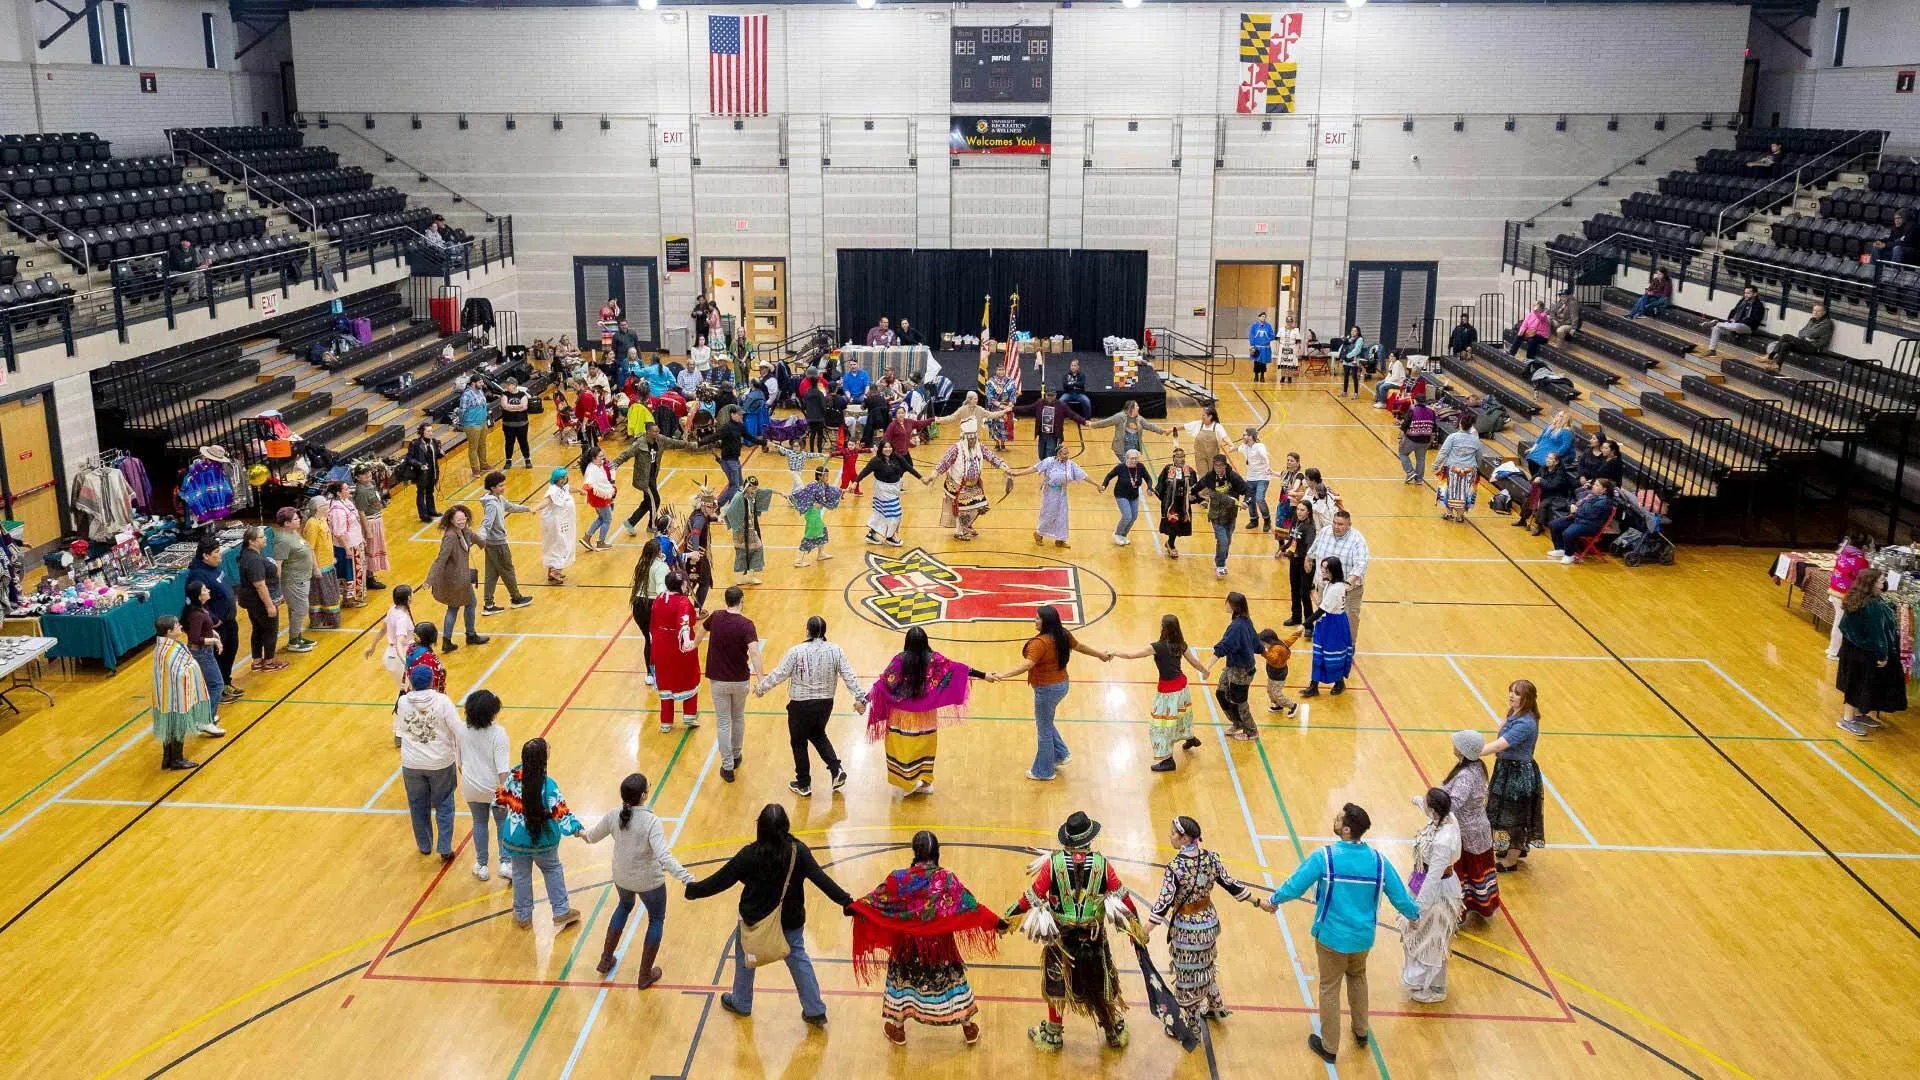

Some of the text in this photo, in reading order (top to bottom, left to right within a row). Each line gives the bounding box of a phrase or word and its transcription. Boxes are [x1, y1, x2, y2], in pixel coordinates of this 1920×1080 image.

[991, 54, 1011, 62] period
[146, 78, 152, 91] E
[1902, 76, 1909, 90] J
[663, 132, 684, 143] EXIT
[965, 135, 1036, 146] Welcomes You!
[1325, 132, 1347, 144] EXIT
[261, 293, 277, 310] EXIT
